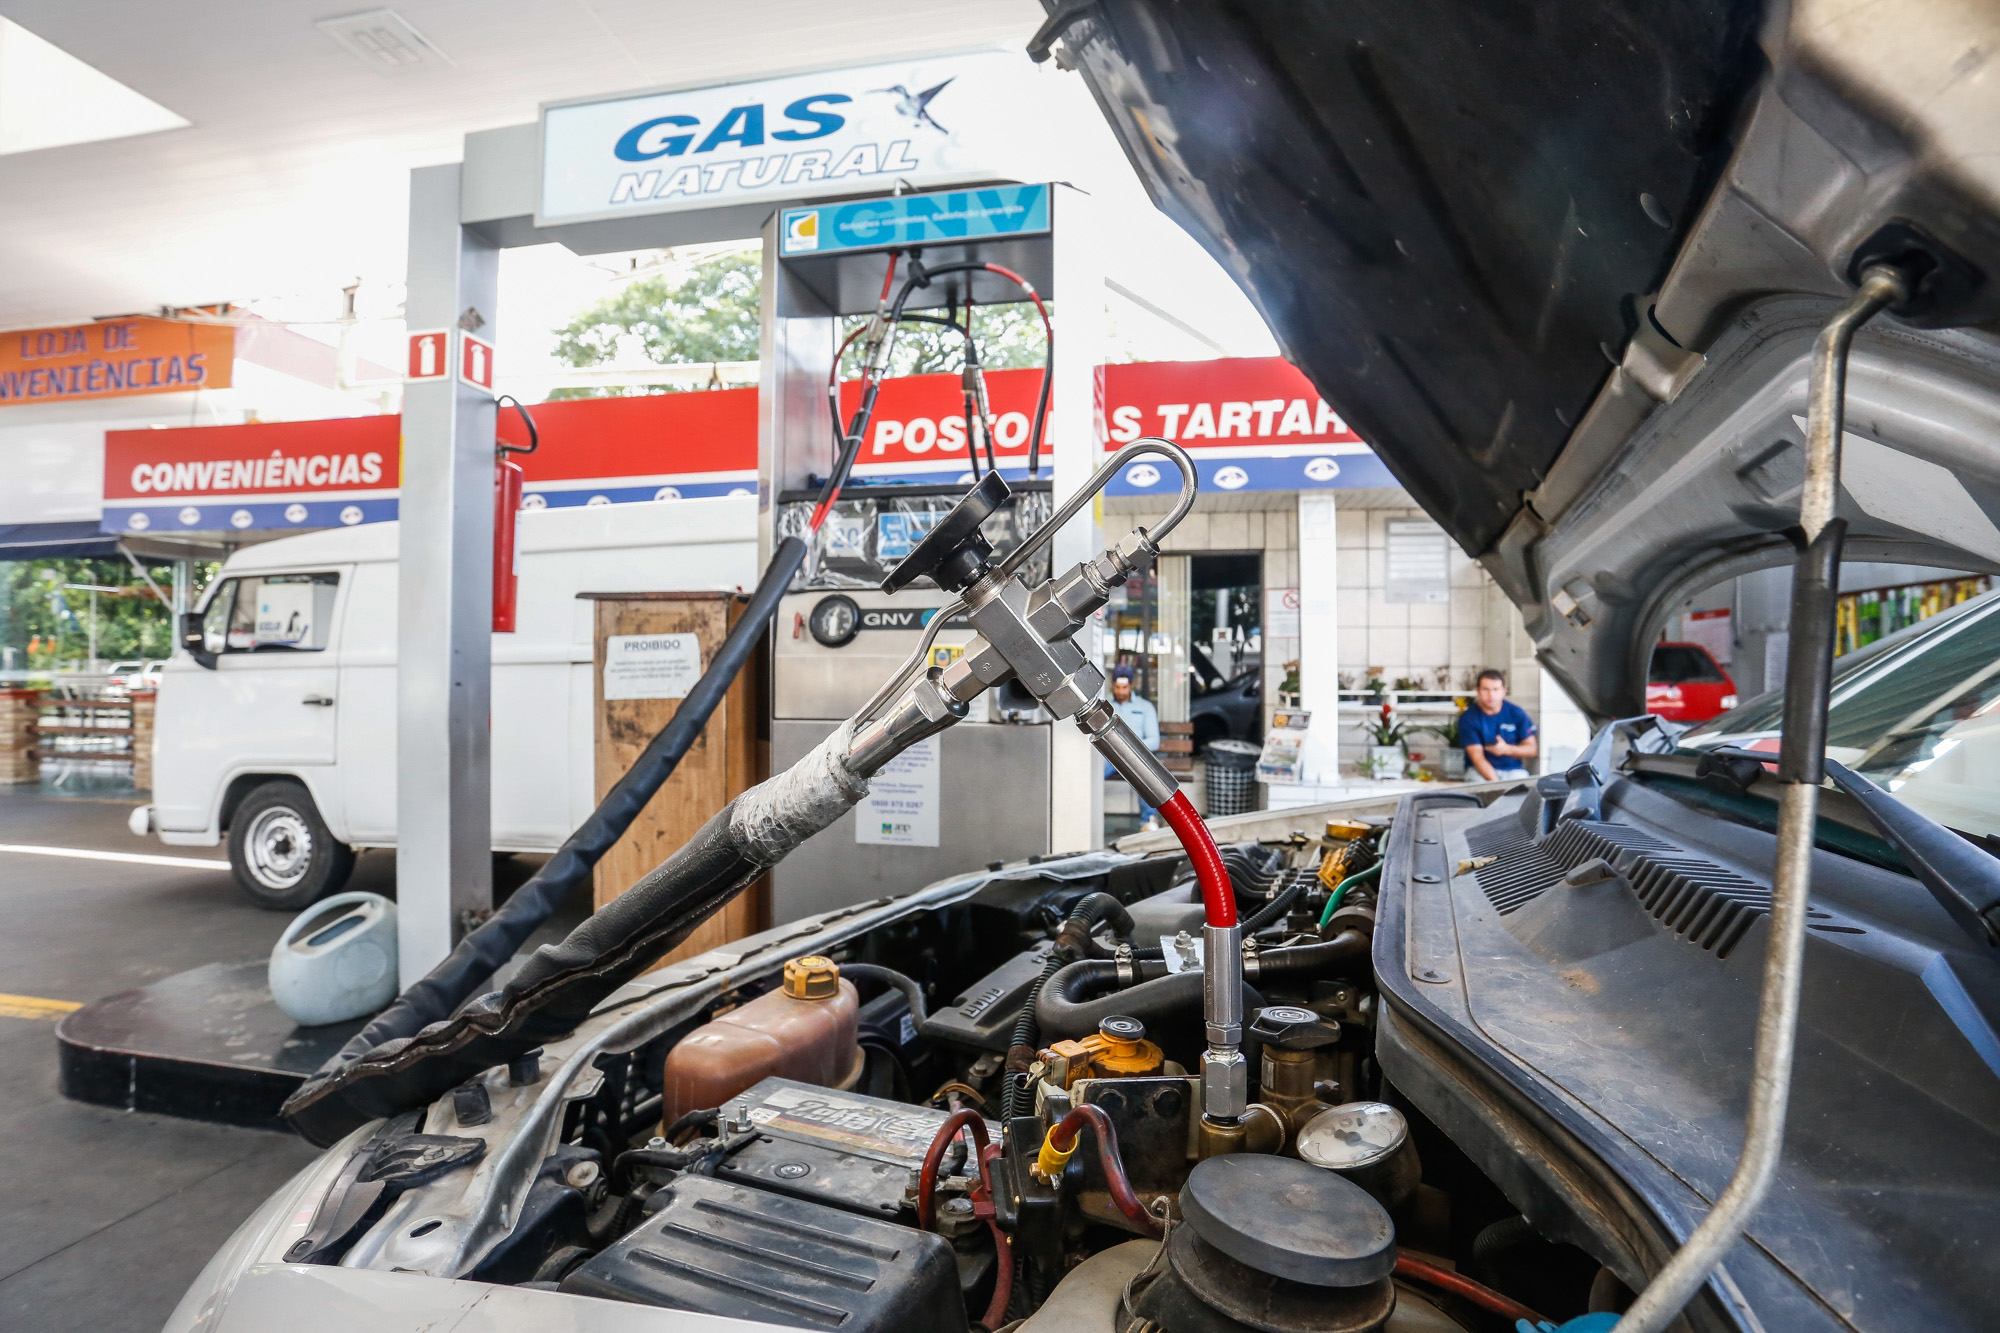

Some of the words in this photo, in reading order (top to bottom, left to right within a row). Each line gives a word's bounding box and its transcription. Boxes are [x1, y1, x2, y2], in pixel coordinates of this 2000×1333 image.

[614, 94, 853, 162] GAS
[609, 139, 918, 204] NATURAL
[833, 186, 1042, 247] GNV
[20, 329, 88, 360] LOJA
[103, 323, 140, 352] DE
[872, 410, 1029, 456] POSTO
[131, 449, 384, 493] CONVENIÊNCIAS
[863, 612, 914, 627] GNV
[624, 640, 681, 652] PROIBIDO
